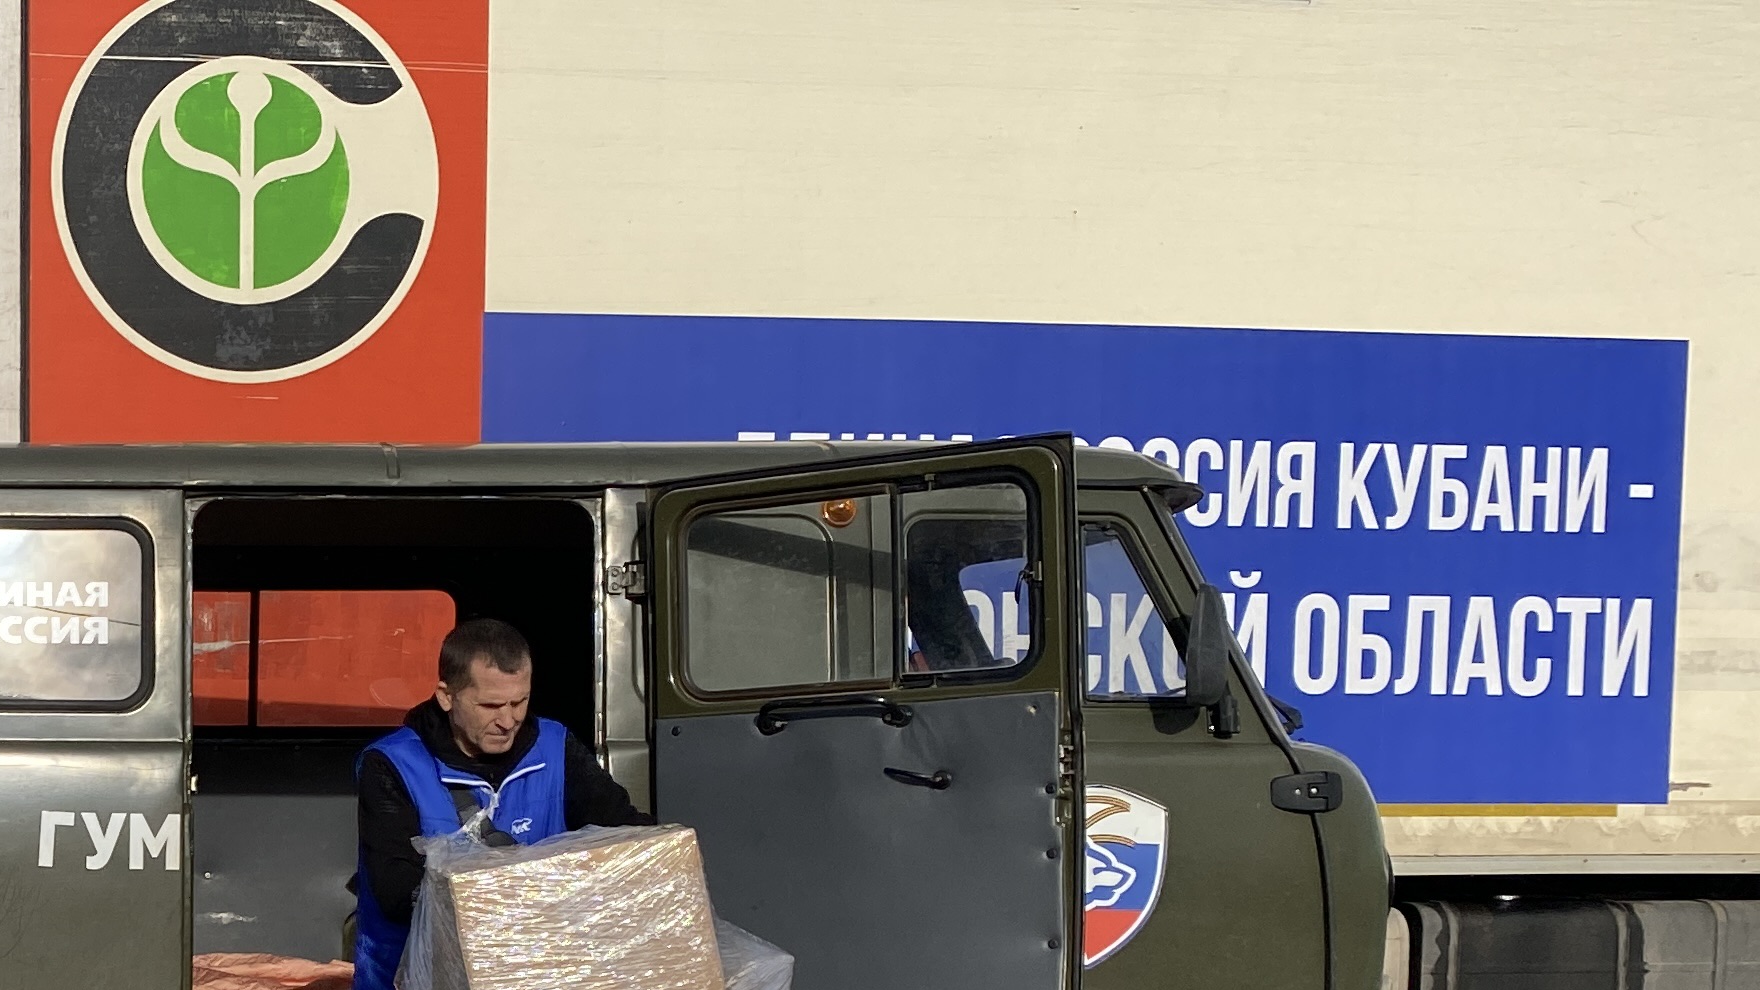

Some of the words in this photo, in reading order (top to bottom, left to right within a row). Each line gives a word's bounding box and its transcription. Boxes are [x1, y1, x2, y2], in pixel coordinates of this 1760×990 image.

[1073, 436, 1316, 529] СИЯ
[1337, 442, 1609, 533] КУБАНИ
[1293, 592, 1653, 697] ОБЛАСТИ
[38, 811, 180, 871] ГУМ
